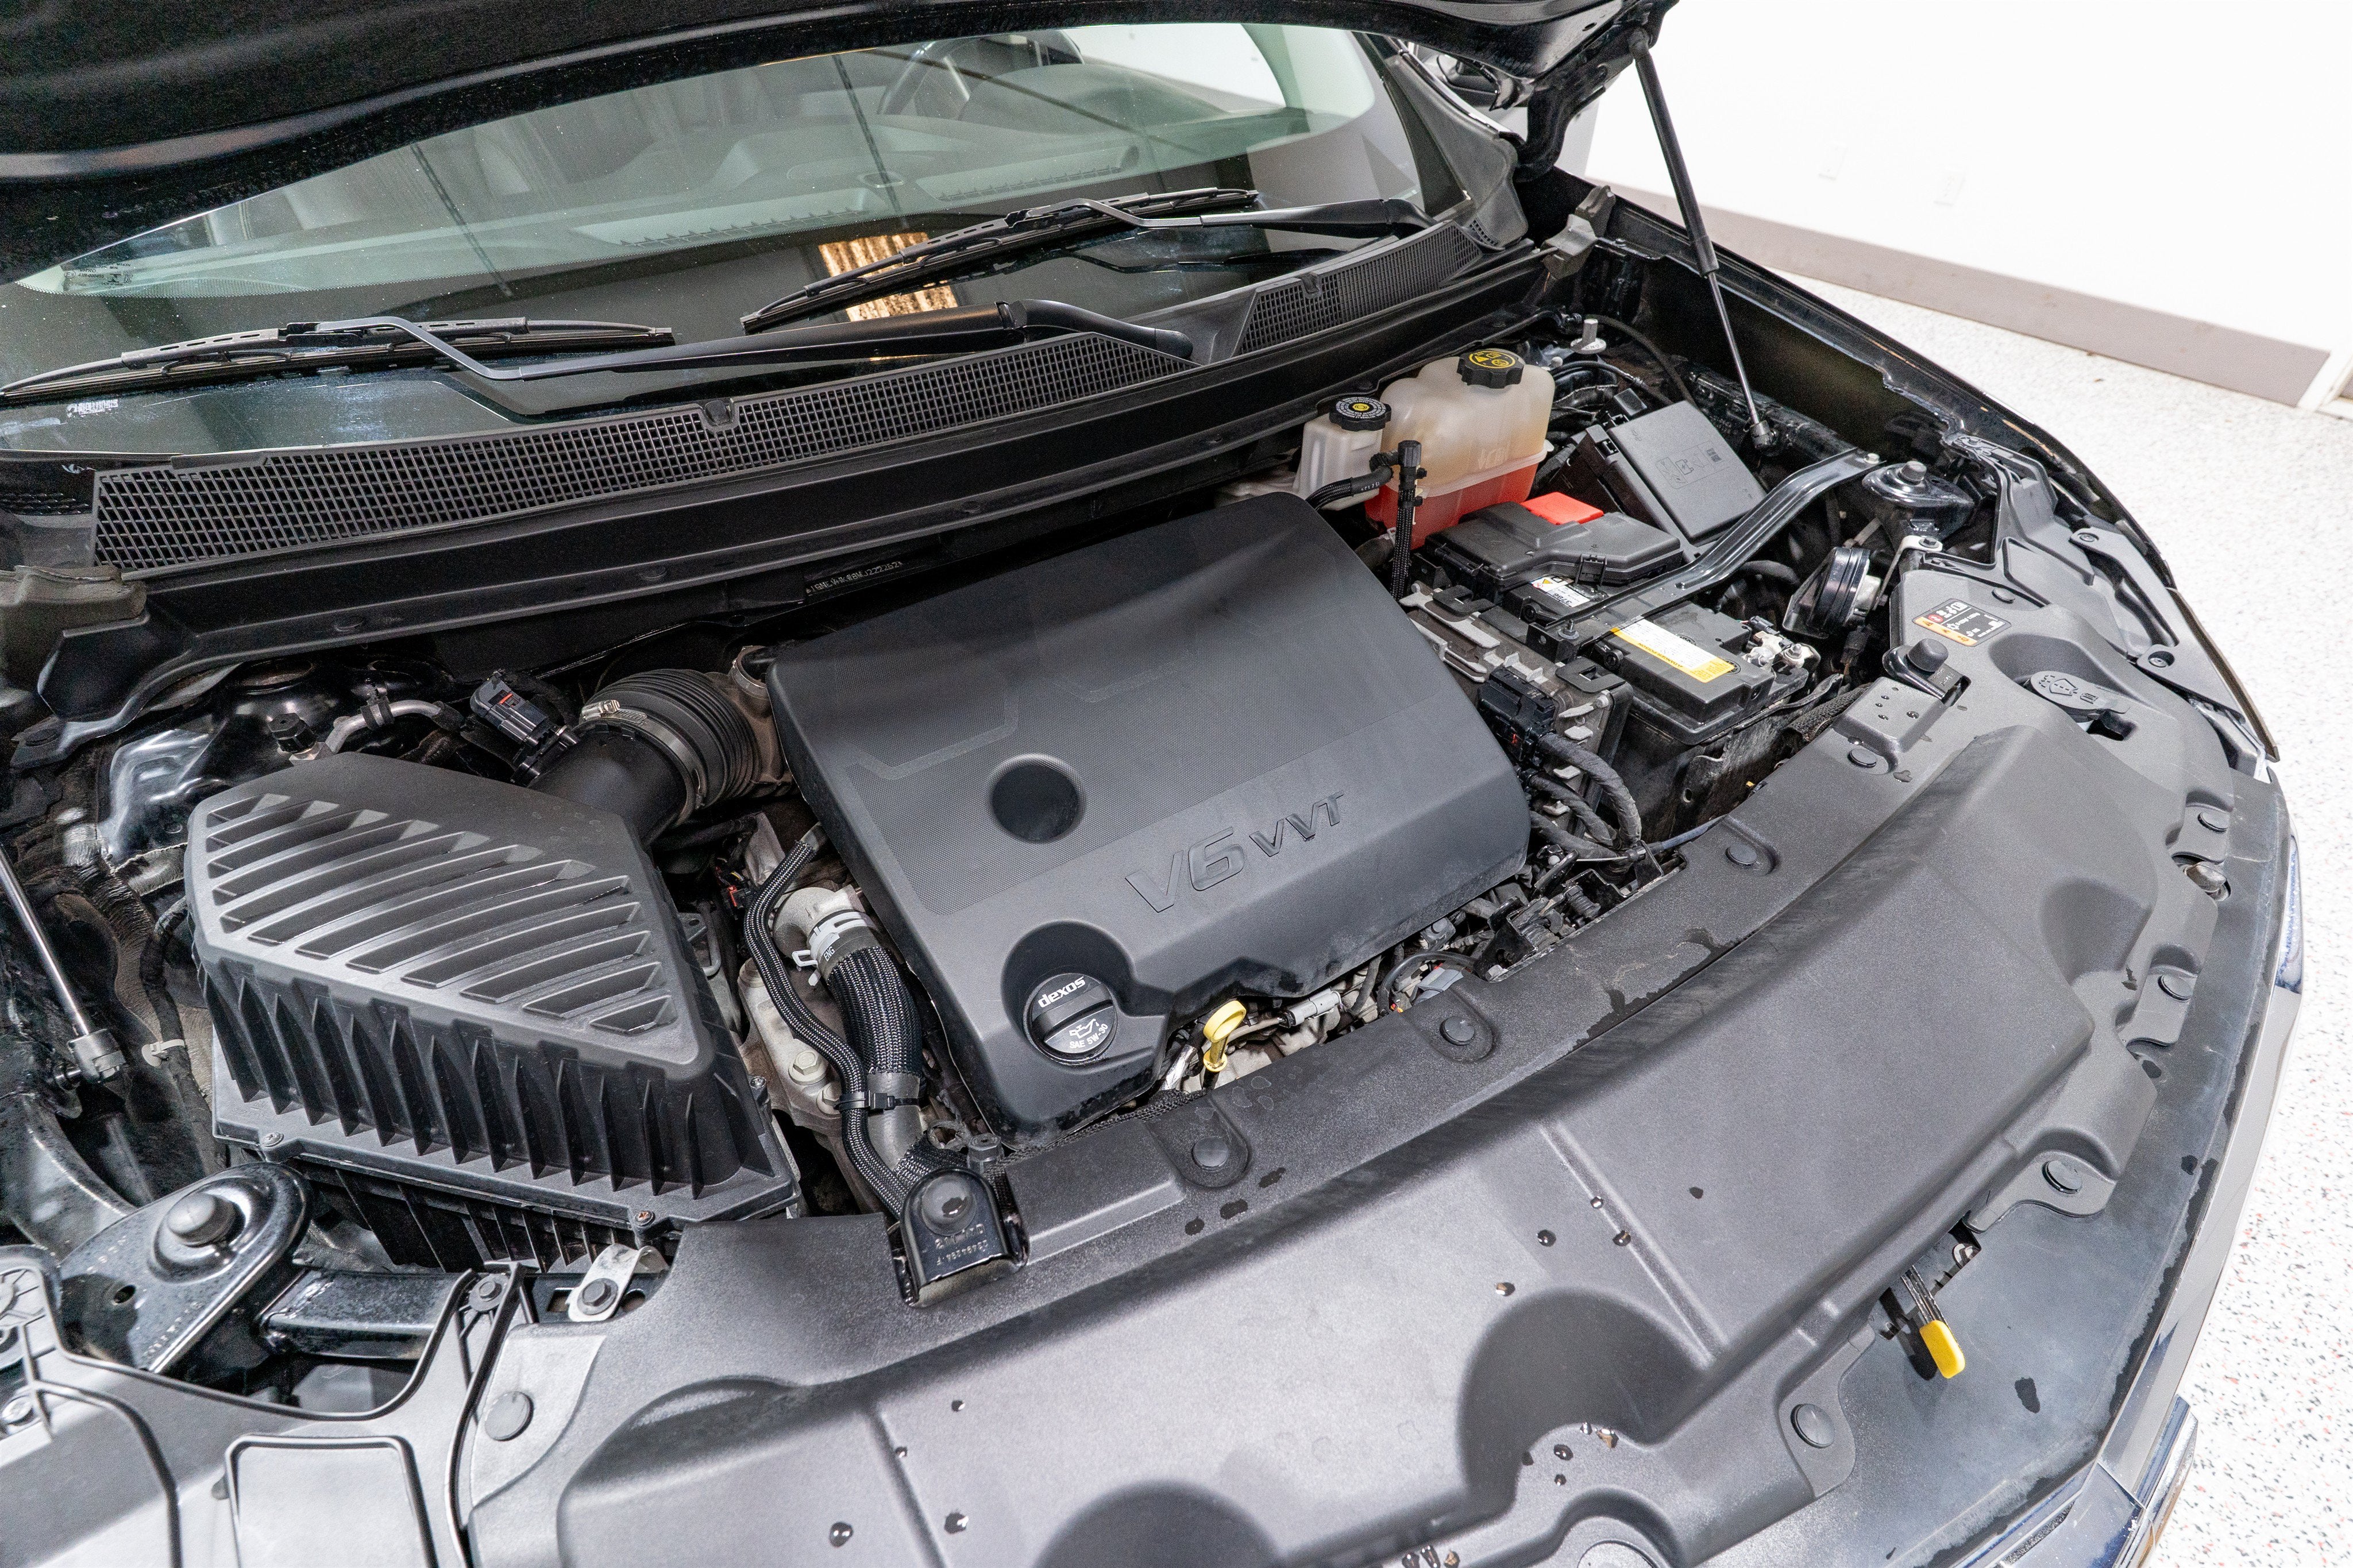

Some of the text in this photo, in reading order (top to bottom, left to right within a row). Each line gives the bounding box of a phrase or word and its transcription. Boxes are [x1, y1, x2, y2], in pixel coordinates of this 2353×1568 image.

[1125, 790, 1345, 913] V6 VVT
[823, 946, 835, 961] ENG
[1037, 976, 1086, 1009] dexos
[1069, 1023, 1108, 1049] SAE 5W-30
